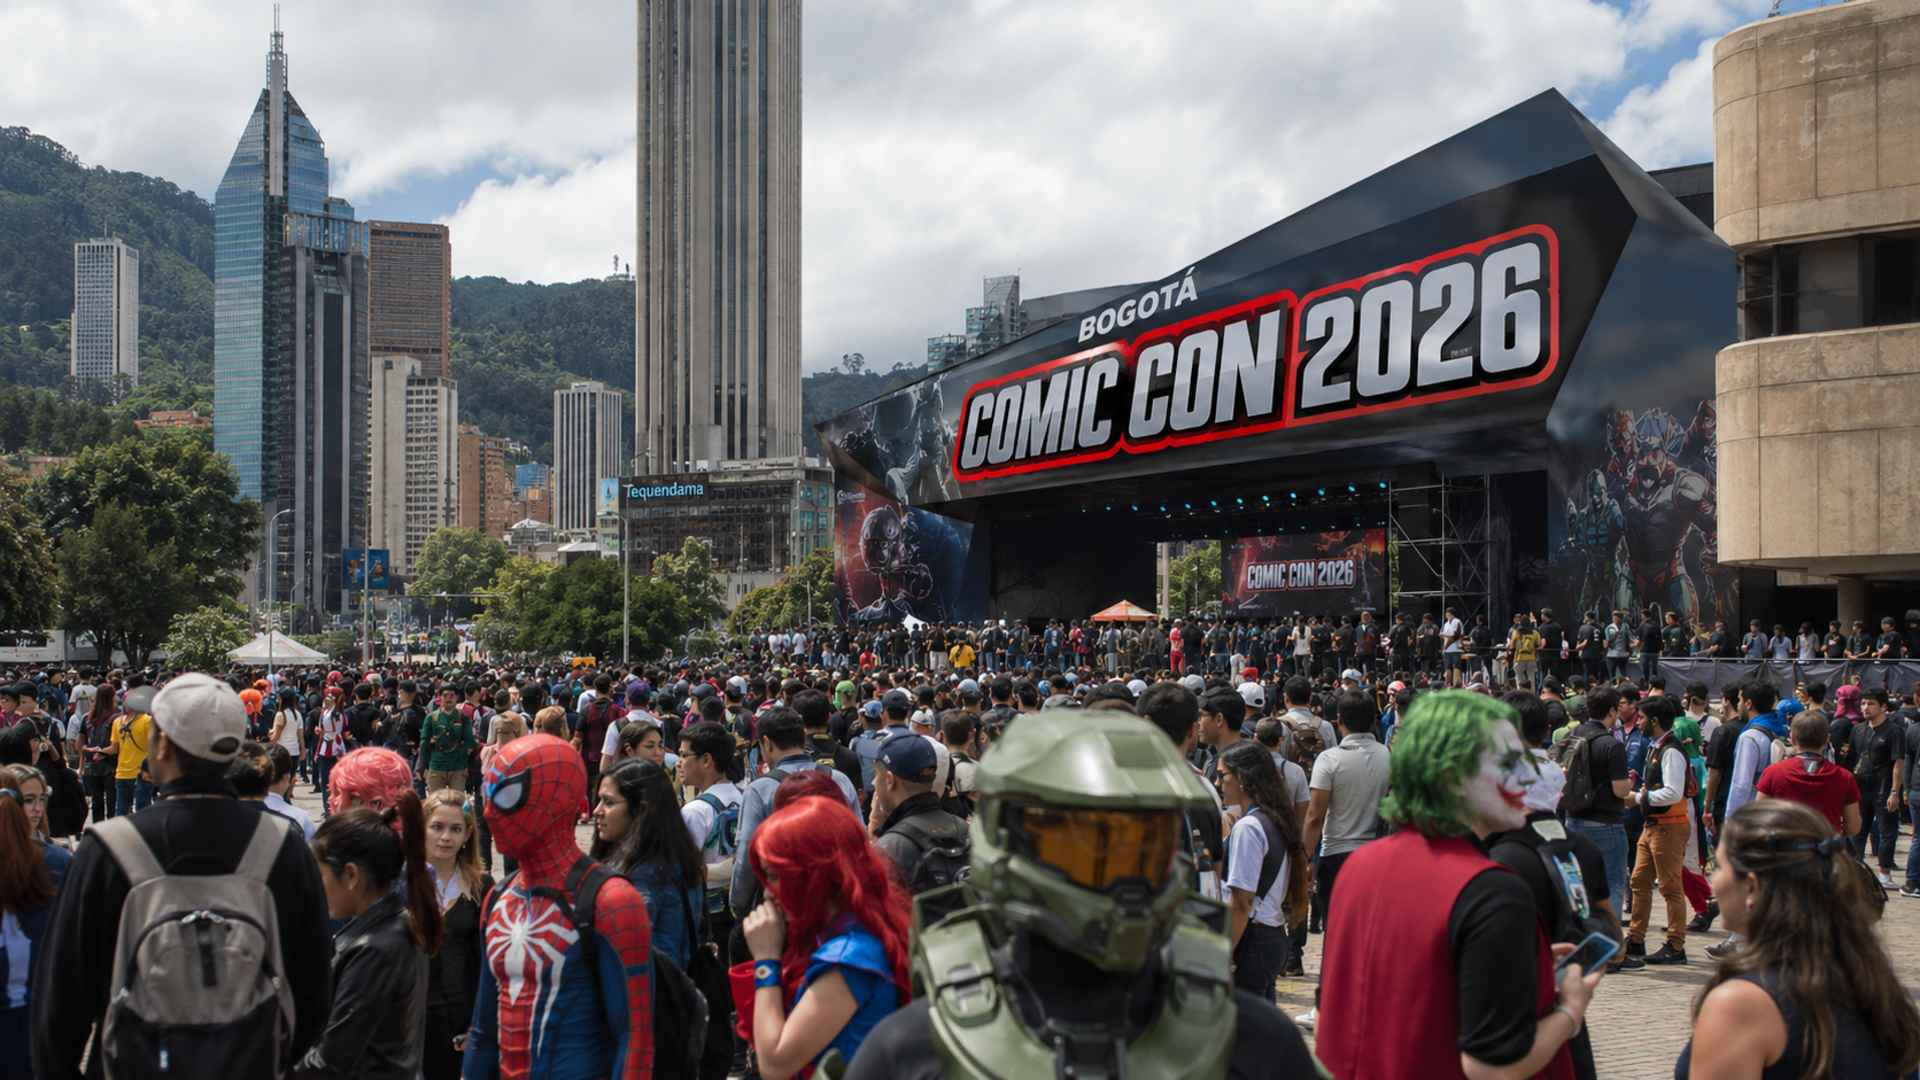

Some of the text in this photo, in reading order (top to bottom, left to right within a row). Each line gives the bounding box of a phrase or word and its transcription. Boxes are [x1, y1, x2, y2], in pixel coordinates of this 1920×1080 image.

[1079, 268, 1198, 343] BOGOTÁ
[961, 243, 1542, 470] COMIC CON 2026
[623, 482, 704, 501] Tequendama
[1247, 559, 1354, 589] COMIC CON 2026
